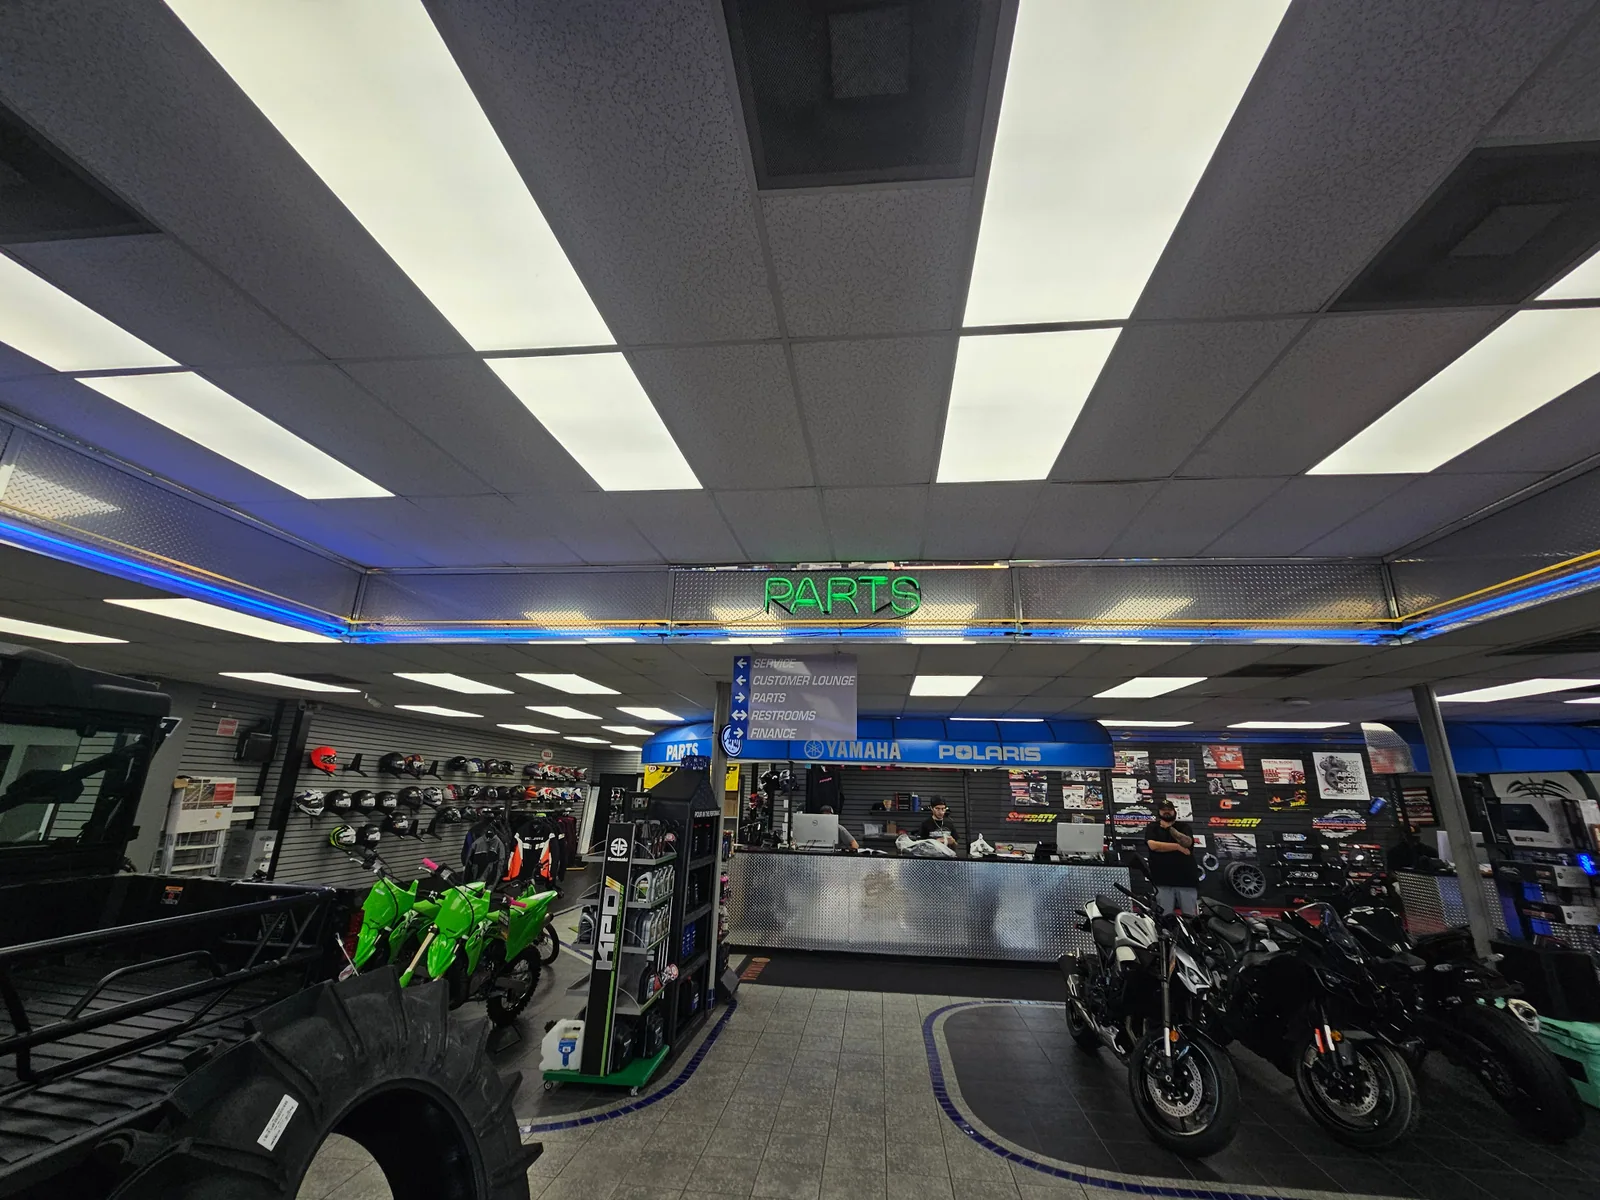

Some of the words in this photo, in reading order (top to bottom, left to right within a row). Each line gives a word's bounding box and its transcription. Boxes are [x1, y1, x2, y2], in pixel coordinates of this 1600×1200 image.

[765, 577, 921, 614] PARTS
[753, 659, 796, 668] SERVICE
[752, 675, 810, 685] CUSTOMER
[812, 675, 855, 685] LOUNGE
[752, 693, 786, 703] PARTS
[751, 710, 816, 721] RESTROOMS
[750, 728, 797, 739] FINANCE
[665, 742, 699, 761] PARTS
[826, 740, 901, 760] YAMAHA
[938, 744, 1041, 762] POLARIS
